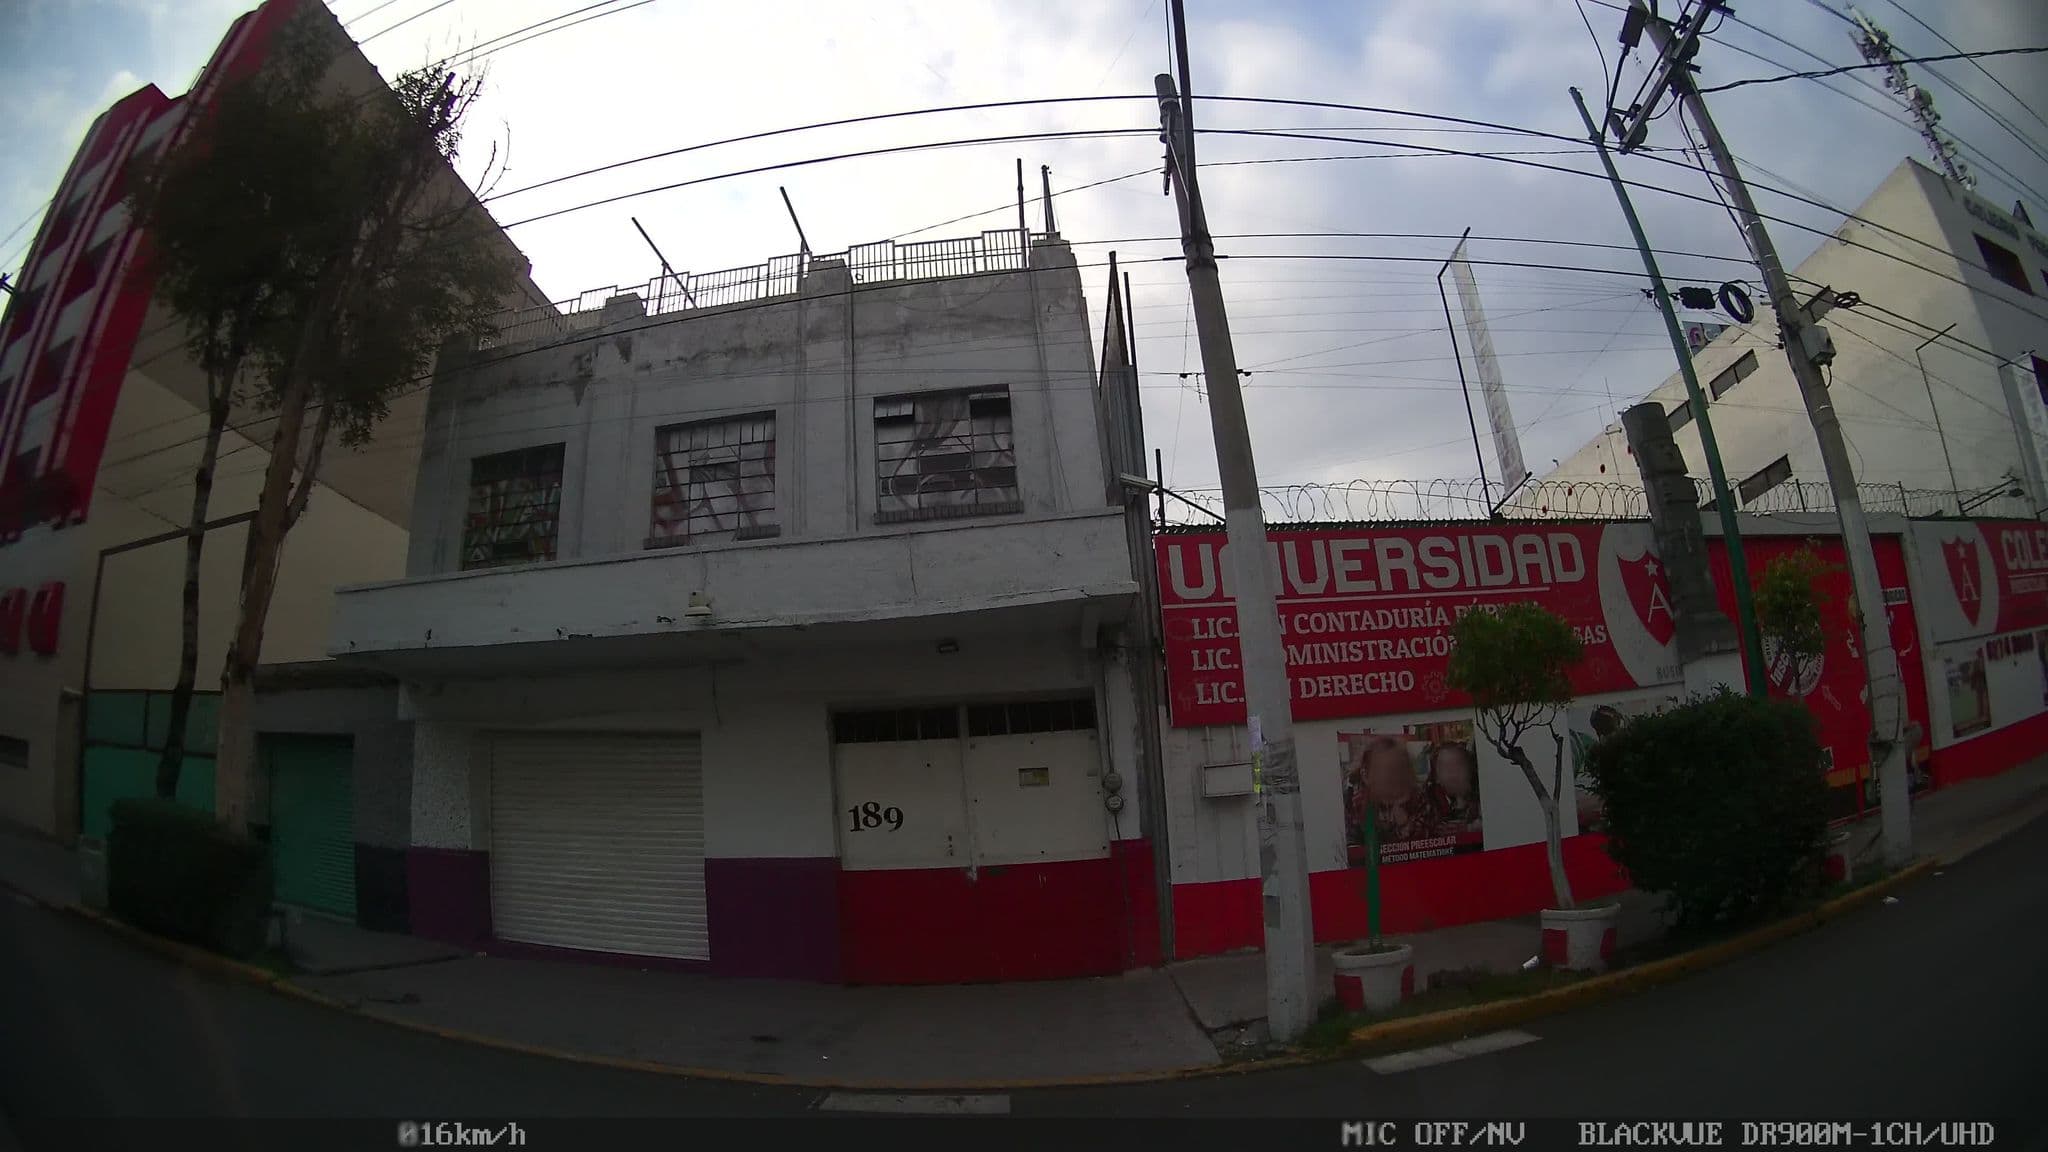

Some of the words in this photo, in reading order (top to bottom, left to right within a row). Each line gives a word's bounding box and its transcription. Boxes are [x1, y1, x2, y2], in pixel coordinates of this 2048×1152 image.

[1962, 561, 1981, 602] A
[1191, 617, 1240, 640] LIC.
[1294, 600, 1450, 635] CONTADURÍA
[1647, 582, 1676, 623] A
[1191, 648, 1240, 672] LIC.
[1195, 681, 1246, 705] LIC.
[1300, 670, 1415, 699] DERECHO
[848, 801, 904, 833] 189
